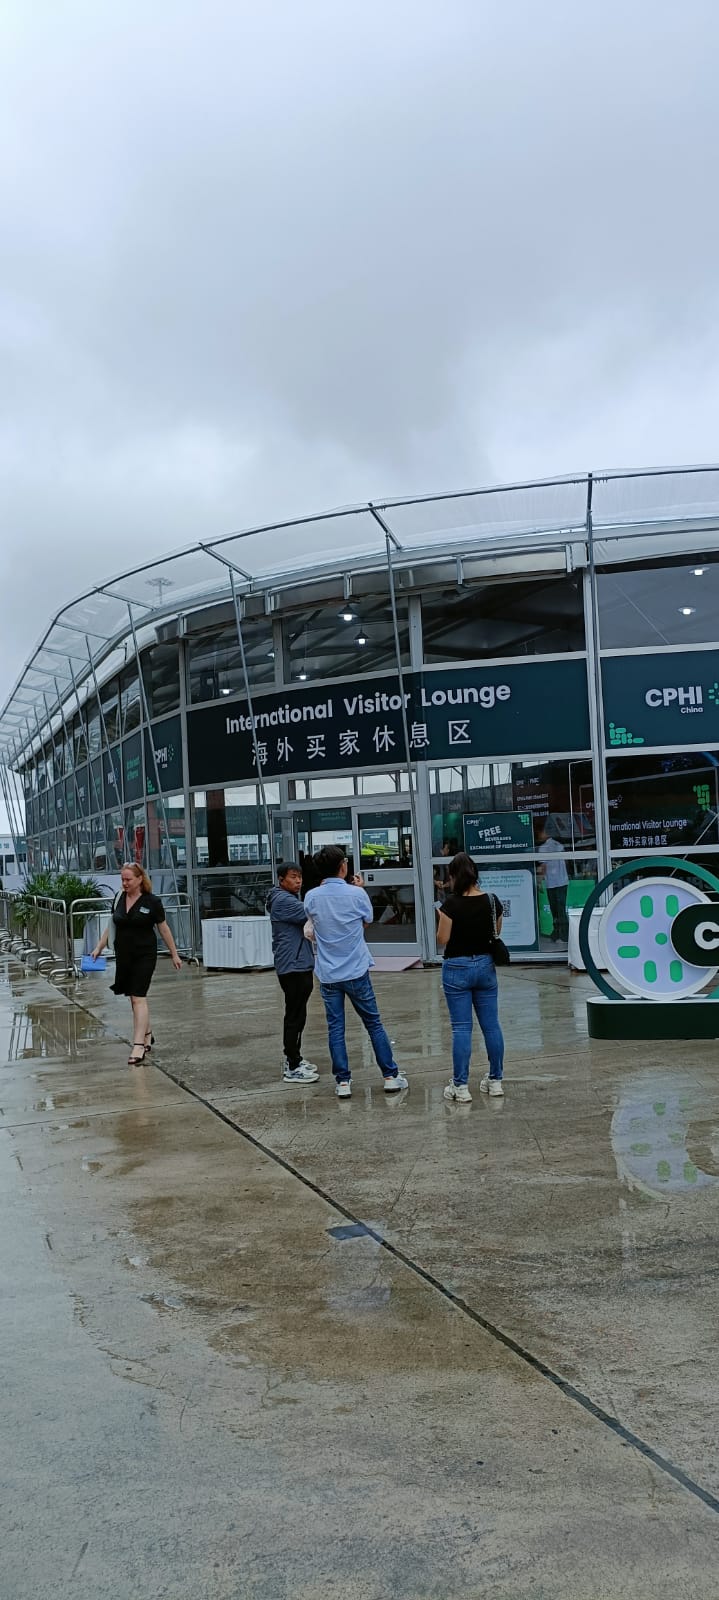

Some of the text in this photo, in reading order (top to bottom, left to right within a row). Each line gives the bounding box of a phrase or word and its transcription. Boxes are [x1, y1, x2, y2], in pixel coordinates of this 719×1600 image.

[645, 686, 703, 707] CPHI
[225, 684, 512, 735] International Visitor Lounge
[680, 706, 704, 714] China
[251, 718, 473, 767] 海外买家休息区
[478, 825, 502, 839] FREE
[641, 819, 662, 830] Visitor
[662, 818, 688, 830] Lounge
